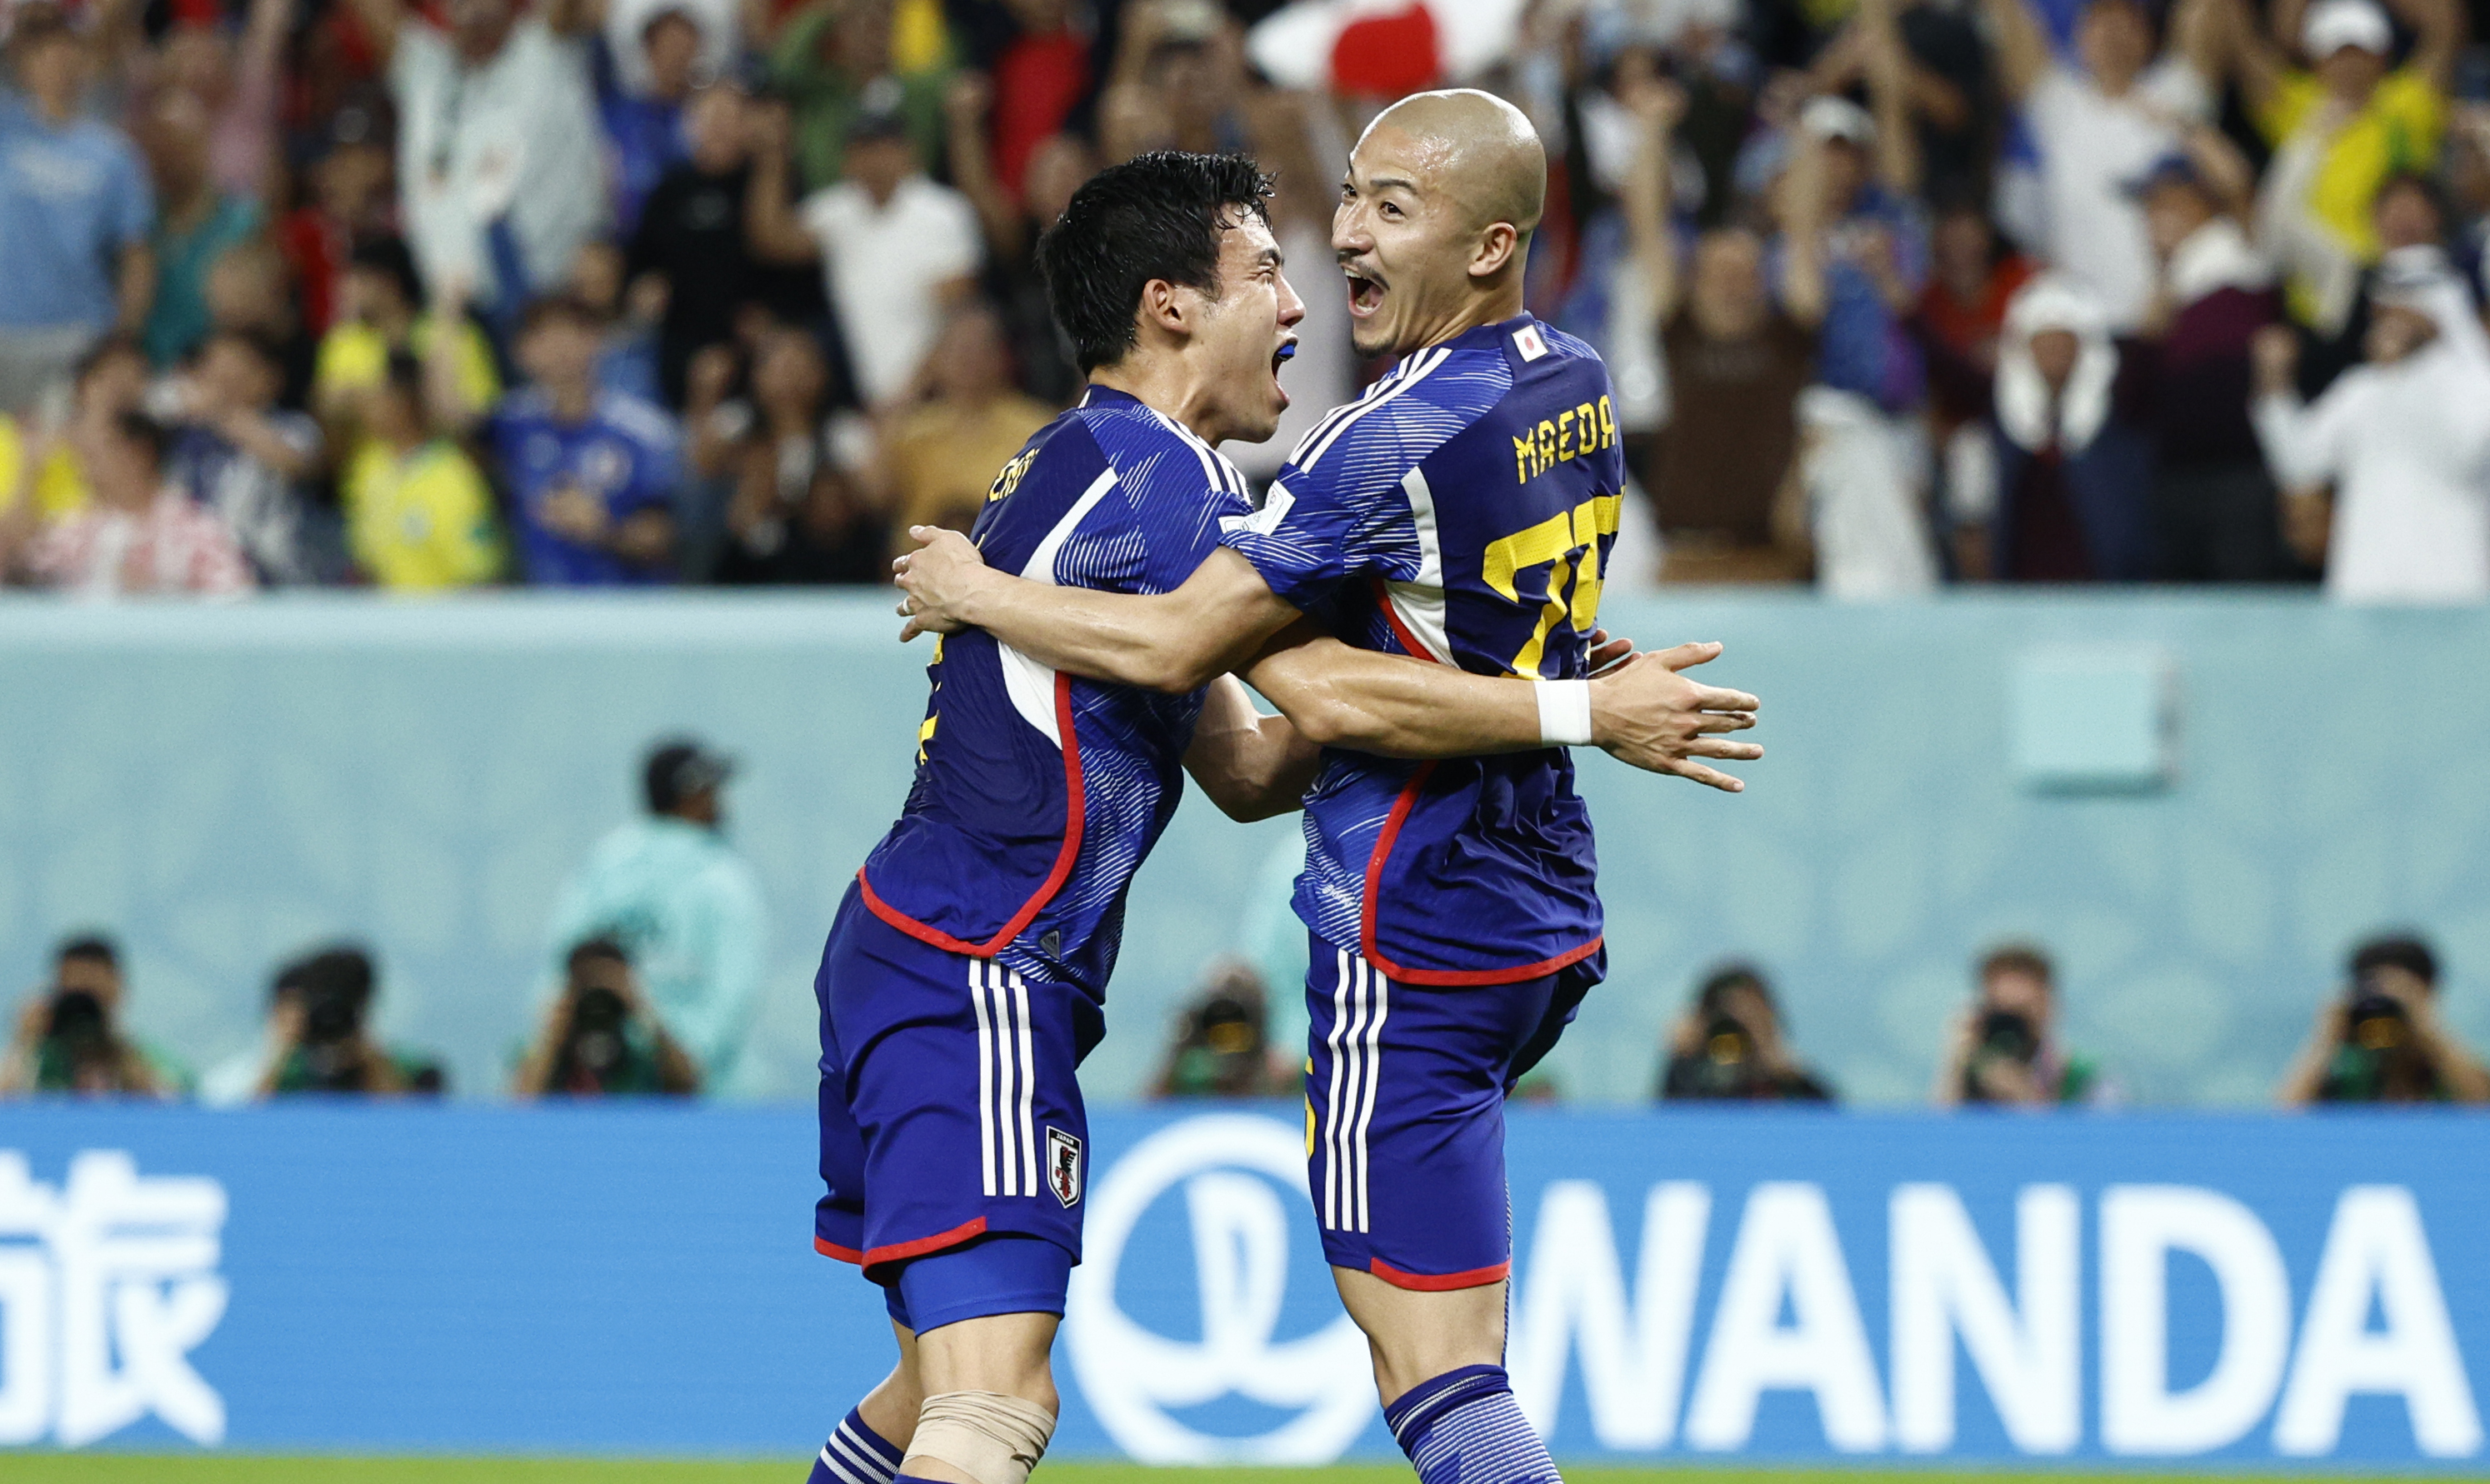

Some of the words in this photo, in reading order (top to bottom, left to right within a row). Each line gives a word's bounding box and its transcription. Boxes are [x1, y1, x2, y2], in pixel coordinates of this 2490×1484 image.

[1512, 394, 1616, 485] MAEDA
[1057, 1133, 1073, 1145] JAPAN
[1505, 1180, 2485, 1457] WANDA
